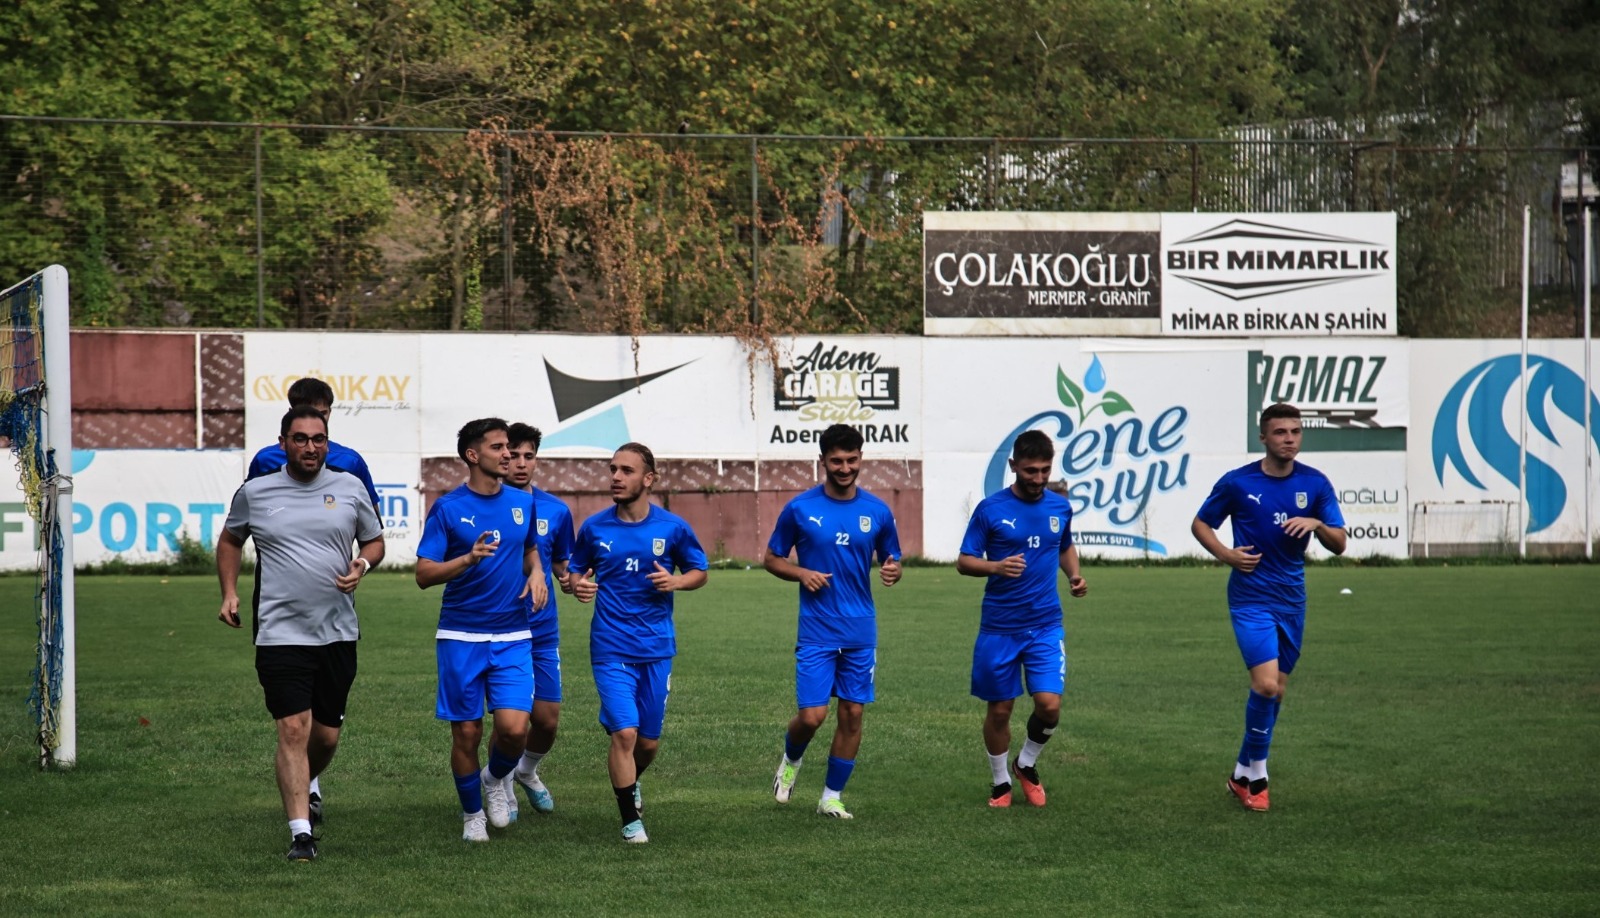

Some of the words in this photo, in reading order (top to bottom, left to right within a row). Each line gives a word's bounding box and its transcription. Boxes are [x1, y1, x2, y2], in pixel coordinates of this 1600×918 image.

[934, 243, 1151, 296] ÇOLAKOĞLU
[1028, 290, 1087, 306] MERMER
[1100, 287, 1151, 306] GRANİT
[1172, 307, 1239, 330] MİMAR
[1244, 307, 1320, 330] BİRKAN
[1325, 307, 1387, 335] ŞAHİN
[795, 340, 881, 373] Adem
[281, 370, 411, 401] NKAY
[784, 373, 890, 398] GARAGE
[798, 399, 875, 424] Style
[984, 405, 1189, 500] Cene
[1273, 512, 1288, 525] 30
[492, 529, 501, 543] 9
[836, 532, 849, 545] 22
[1026, 535, 1041, 548] 13
[1110, 535, 1134, 546] SUYU
[625, 557, 640, 572] 21
